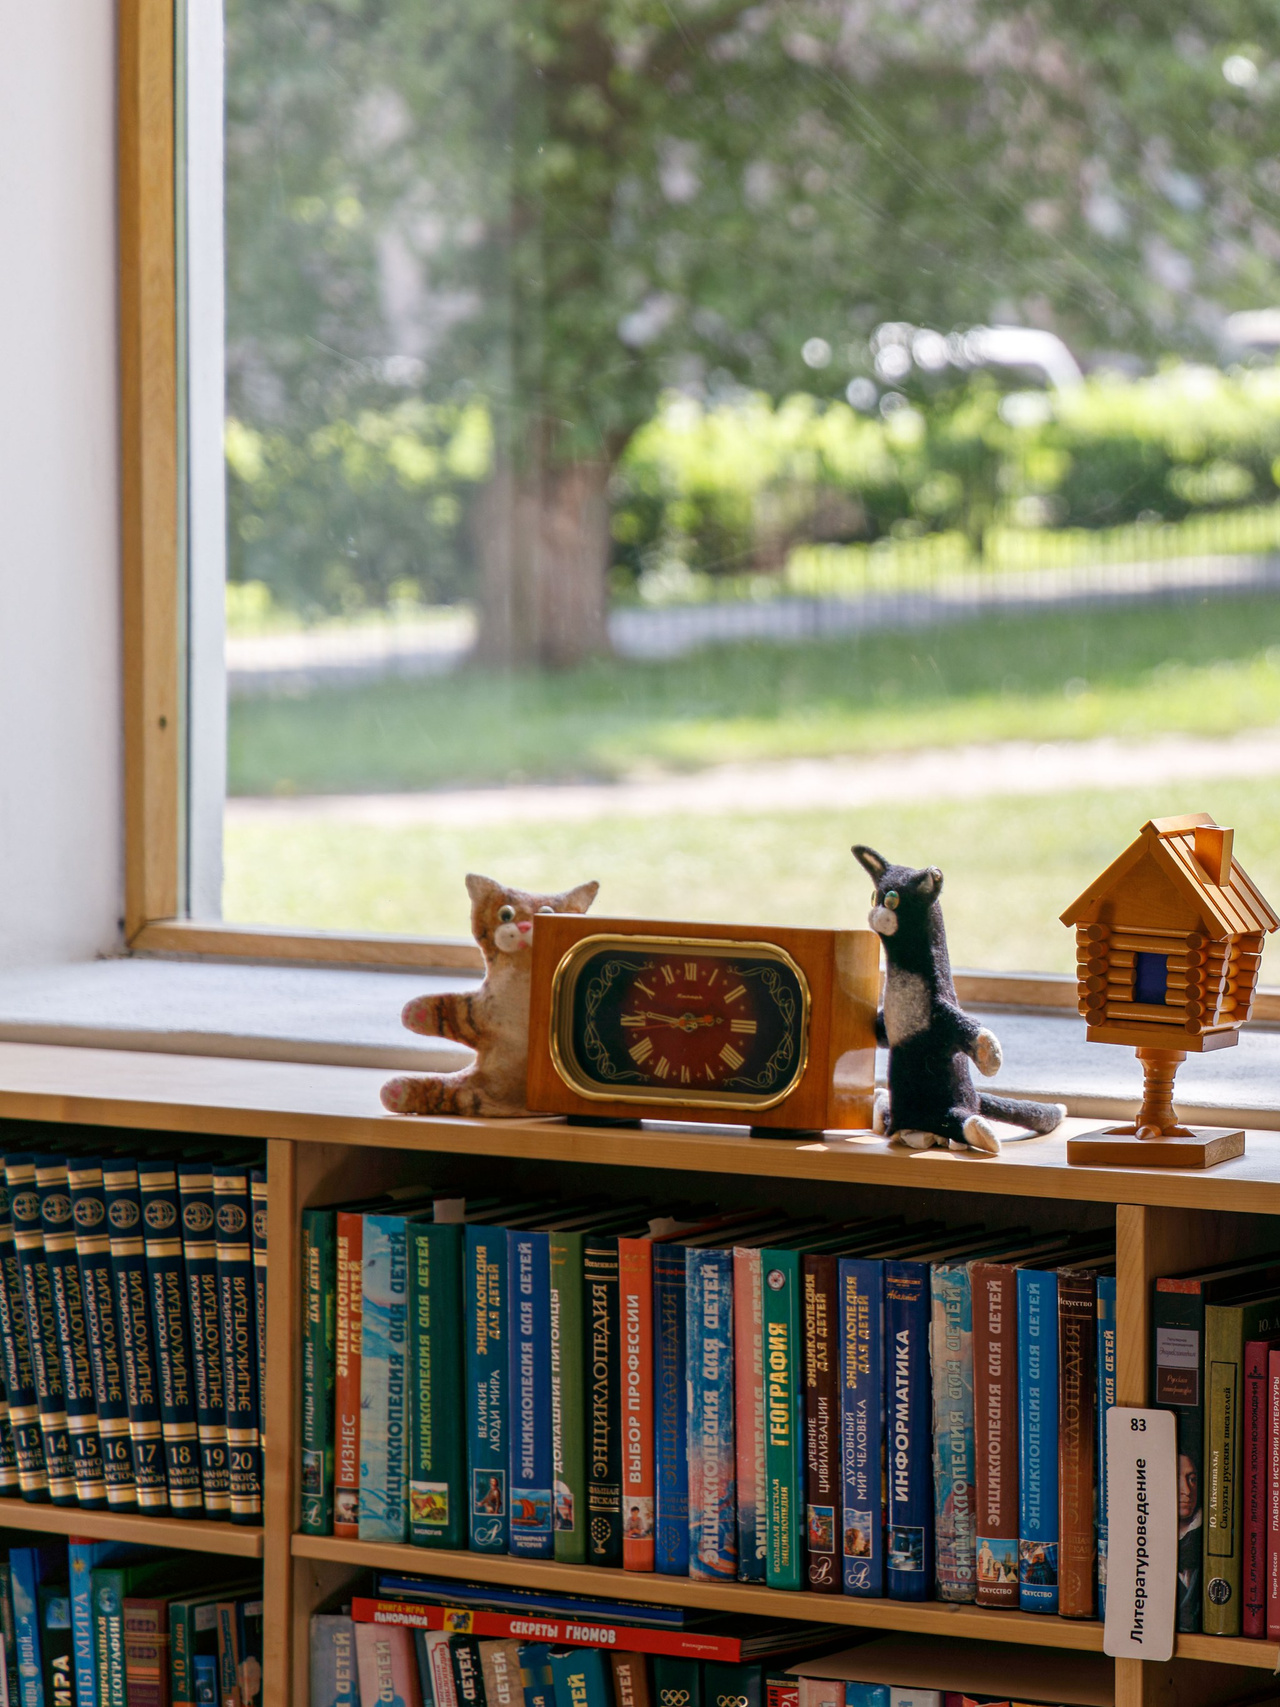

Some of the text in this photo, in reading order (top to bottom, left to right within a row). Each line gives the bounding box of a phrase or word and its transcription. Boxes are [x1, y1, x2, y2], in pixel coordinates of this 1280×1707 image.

[35, 1262, 62, 1395] ЭНЦИКЛОПЕДИЯ
[65, 1265, 92, 1398] ЭНЦИКЛОПЕДИЯ
[308, 1246, 320, 1322] ДЛЯ ДЕТЕЙ
[337, 1236, 350, 1377] ЭНЦИКЛОПЕДИЯ
[476, 1246, 487, 1355] ЭНЦИКЛОПЕДИЯ
[487, 1264, 500, 1340] ДЛЯ ДЕТЕЙ
[814, 1292, 828, 1372] ДЛЯ ДЕТЕЙ
[96, 1268, 122, 1401] ЭНЦИКЛОПЕДИЯ
[129, 1270, 154, 1404] ЭНЦИКЛОПЕДИЯ
[165, 1271, 188, 1405] ЭНЦИКЛОПЕДИЯ
[202, 1274, 223, 1408] ЭНЦИКЛОПЕДИЯ
[233, 1277, 251, 1411] ЭНЦИКЛОПЕДИЯ
[386, 1231, 406, 1520] ЭНЦИКЛОПЕДИЯ ДЛЯ ДЕТЕЙ
[416, 1236, 430, 1470] ЭНЦИКЛОПЕДИЯ ДЛЯ ДЕТЕЙ
[518, 1242, 534, 1479] ЭНЦИКЛОПЕДИЯ ДЛЯ ДЕТЕЙ
[591, 1284, 610, 1477] ЭНЦИКЛОПЕДИЯ
[304, 1343, 314, 1441] ПТИЦЫ И ЗВЕРИ
[477, 1382, 487, 1438] ВЕЛИКИЕ
[489, 1370, 501, 1451] ЛЮДИ МИРА
[627, 1294, 641, 1483] ВЫБОР ПРОФЕССИИ
[662, 1293, 680, 1487] ЭНЦИКЛОПЕДИЯ
[700, 1264, 720, 1564] ЭНЦИКЛОПЕДИЯ ДЛЯ ДЕТЕЙ
[768, 1322, 789, 1446] ГЕОГРАФИЯ
[895, 1330, 910, 1501] ИНФОРМАТИКА
[986, 1280, 1001, 1526] ЭНЦИКЛОПЕДИЯ ДЛЯ ДЕТЕЙ
[1026, 1283, 1041, 1529] ЭНЦИКЛОПЕДИЯ ДЛЯ ДЕТЕЙ
[1065, 1323, 1083, 1525] ЭНЦИКЛОПЕДИЯ
[1130, 1418, 1146, 1431] 83
[1251, 1381, 1259, 1441] ВОЗРОЖДЕНИЯ
[49, 1435, 68, 1454] 14
[77, 1437, 96, 1456] 15
[106, 1441, 127, 1459] 16
[137, 1444, 156, 1463] 17
[171, 1446, 191, 1465] 18
[204, 1449, 224, 1466] 19
[232, 1452, 252, 1470] 20
[342, 1414, 356, 1482] БИЗНЕС
[808, 1417, 818, 1472] ДРЕВНИЕ
[818, 1397, 830, 1493] ЦИВИЛИЗАЦИИ
[844, 1412, 856, 1486] ДУХОВНЫЙ
[856, 1399, 867, 1499] МИР ЧЕЛОВЕКА
[943, 1286, 972, 1579] ЭНЦИКЛОПЕДИЯ ДЛЯ ДЕТЕЙ
[1130, 1459, 1149, 1643] Литературоведение
[1209, 1514, 1217, 1528] Ю.
[74, 1592, 90, 1658] МИРА
[109, 1616, 123, 1705] ГЕОГРАФИИ
[333, 1632, 350, 1694] ДЕТЕЙ
[374, 1611, 428, 1627] ПАНОРАМКА
[510, 1620, 616, 1644] СЕКРЕТЫ ГНОМОВ
[455, 1647, 476, 1700] ДЕТЕЙ
[491, 1652, 510, 1704] ДЕТЕЙ
